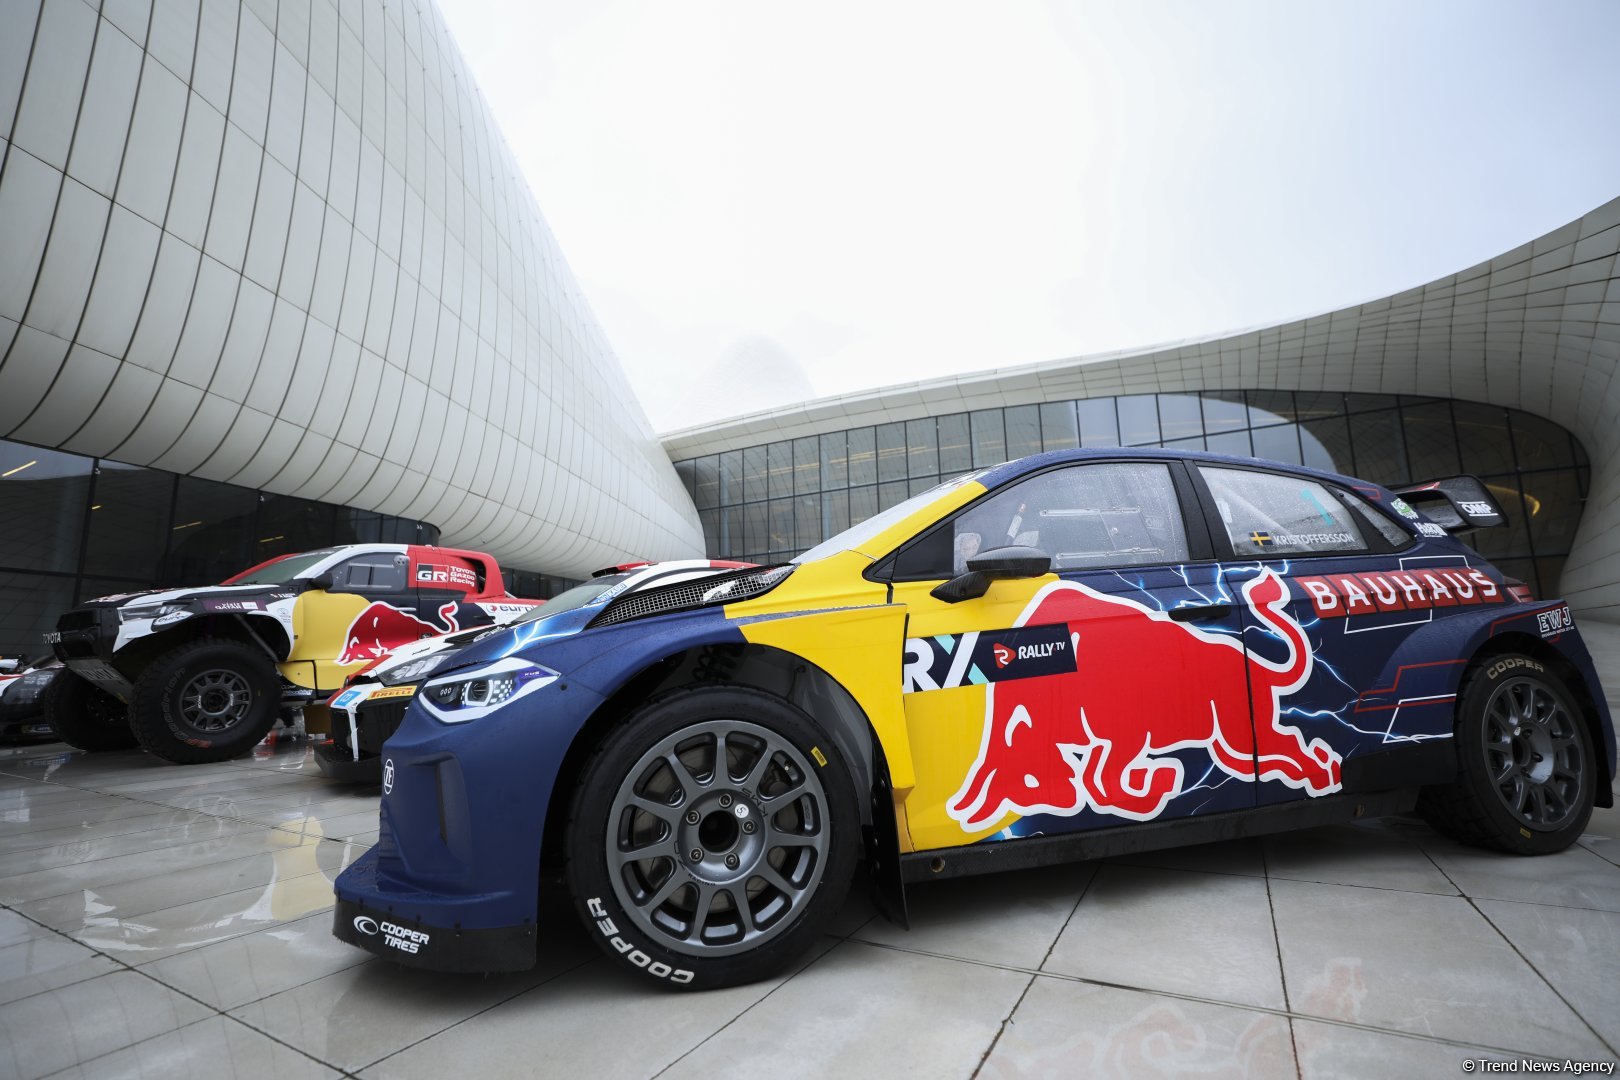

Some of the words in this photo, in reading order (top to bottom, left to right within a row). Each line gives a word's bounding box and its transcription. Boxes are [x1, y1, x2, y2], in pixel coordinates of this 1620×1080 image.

[1460, 503, 1493, 514] OMP
[1273, 533, 1355, 546] KRISTOFFERSSON
[418, 570, 449, 581] GR
[450, 566, 476, 575] TOYOTA
[450, 572, 475, 580] GAZOO
[450, 577, 475, 587] Racing
[1304, 569, 1497, 610] BAUHAUS
[1537, 607, 1572, 633] EWJ
[42, 632, 62, 644] TOYOTA
[1486, 658, 1544, 680] COOPER
[370, 688, 413, 698] PIRELLI
[380, 921, 430, 945] COOPER
[384, 934, 420, 954] TIRES
[587, 897, 695, 984] COOPER
